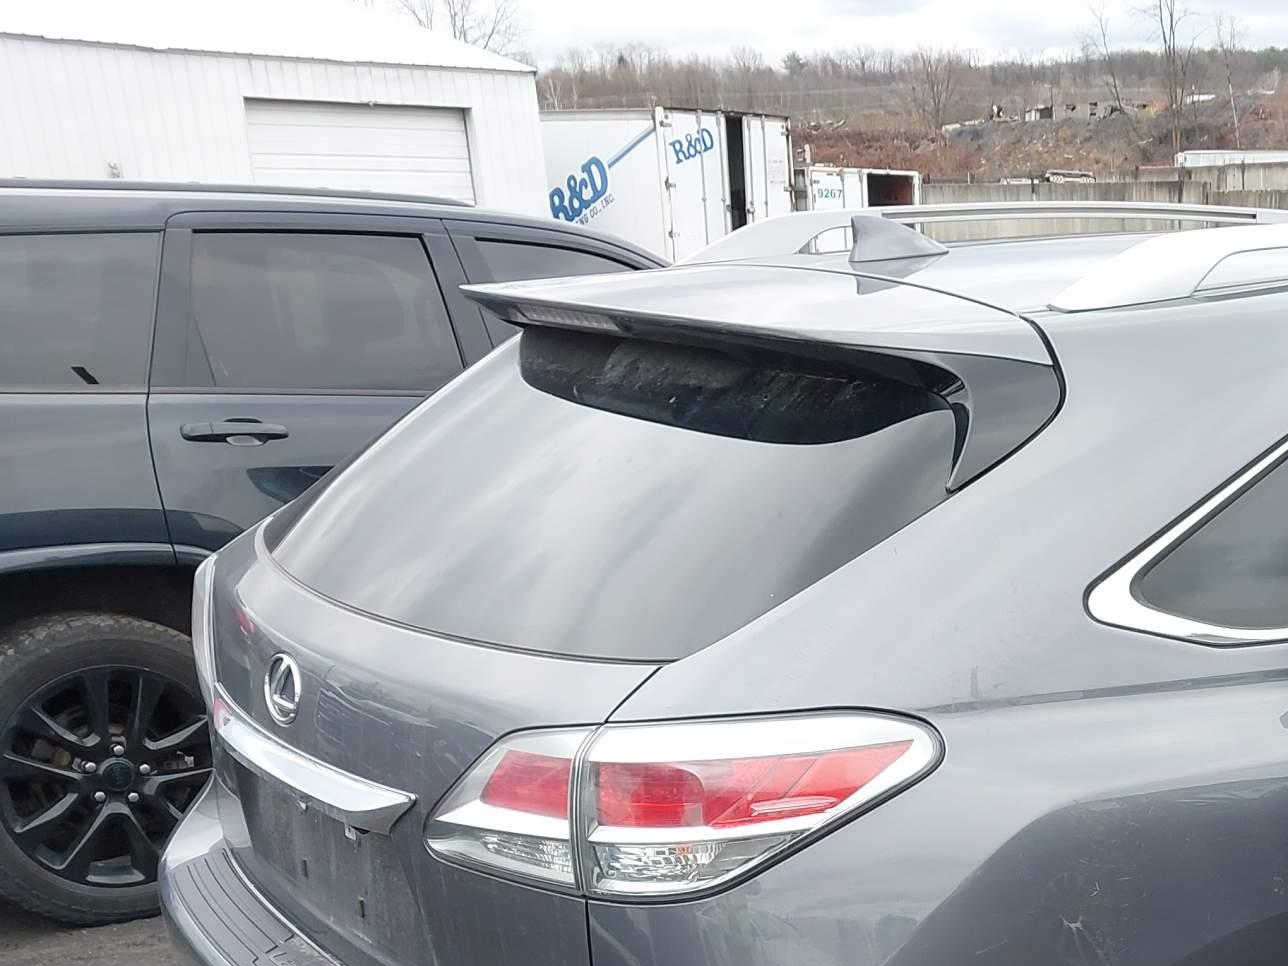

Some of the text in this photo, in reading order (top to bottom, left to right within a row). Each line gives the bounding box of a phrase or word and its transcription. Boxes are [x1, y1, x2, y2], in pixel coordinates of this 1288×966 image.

[668, 127, 714, 165] R&D
[548, 156, 609, 223] R&D
[817, 188, 843, 199] 9267
